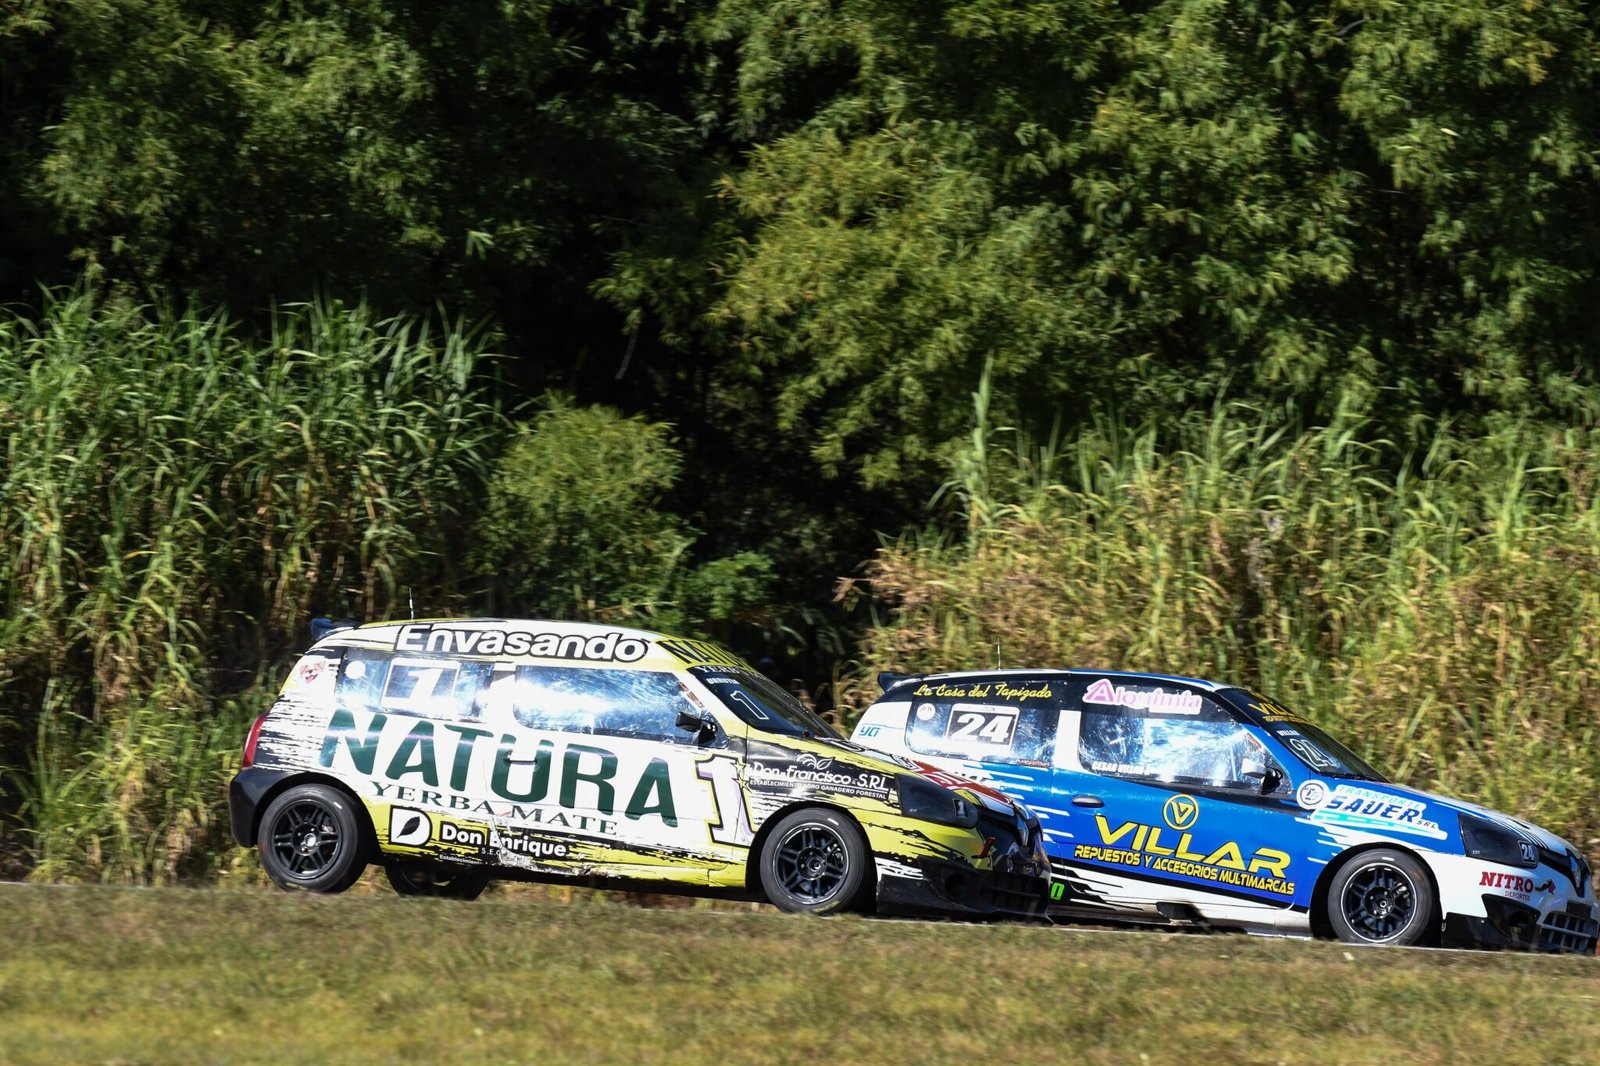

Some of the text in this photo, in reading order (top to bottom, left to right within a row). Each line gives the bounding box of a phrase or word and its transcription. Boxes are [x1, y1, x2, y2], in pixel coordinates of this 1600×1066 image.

[400, 626, 646, 661] Envasando
[408, 667, 443, 701] 1
[914, 683, 1053, 702] La Casa del Tapizado
[730, 690, 769, 720] 1
[950, 713, 1014, 743] 24
[319, 708, 678, 828] NATURA
[373, 781, 619, 836] YERBA MATE
[695, 753, 756, 849] 1
[821, 784, 855, 795] GANADERO
[856, 789, 888, 800] FORESTAL
[1326, 795, 1437, 830] SAUER SRL
[442, 823, 567, 858] Don Enrique
[1095, 815, 1292, 879] VILLAR
[1521, 844, 1535, 860] 24
[1074, 845, 1295, 896] REPUESTOS Y ACCESORIOS MULTIMARCAS
[1479, 871, 1534, 894] NITRO
